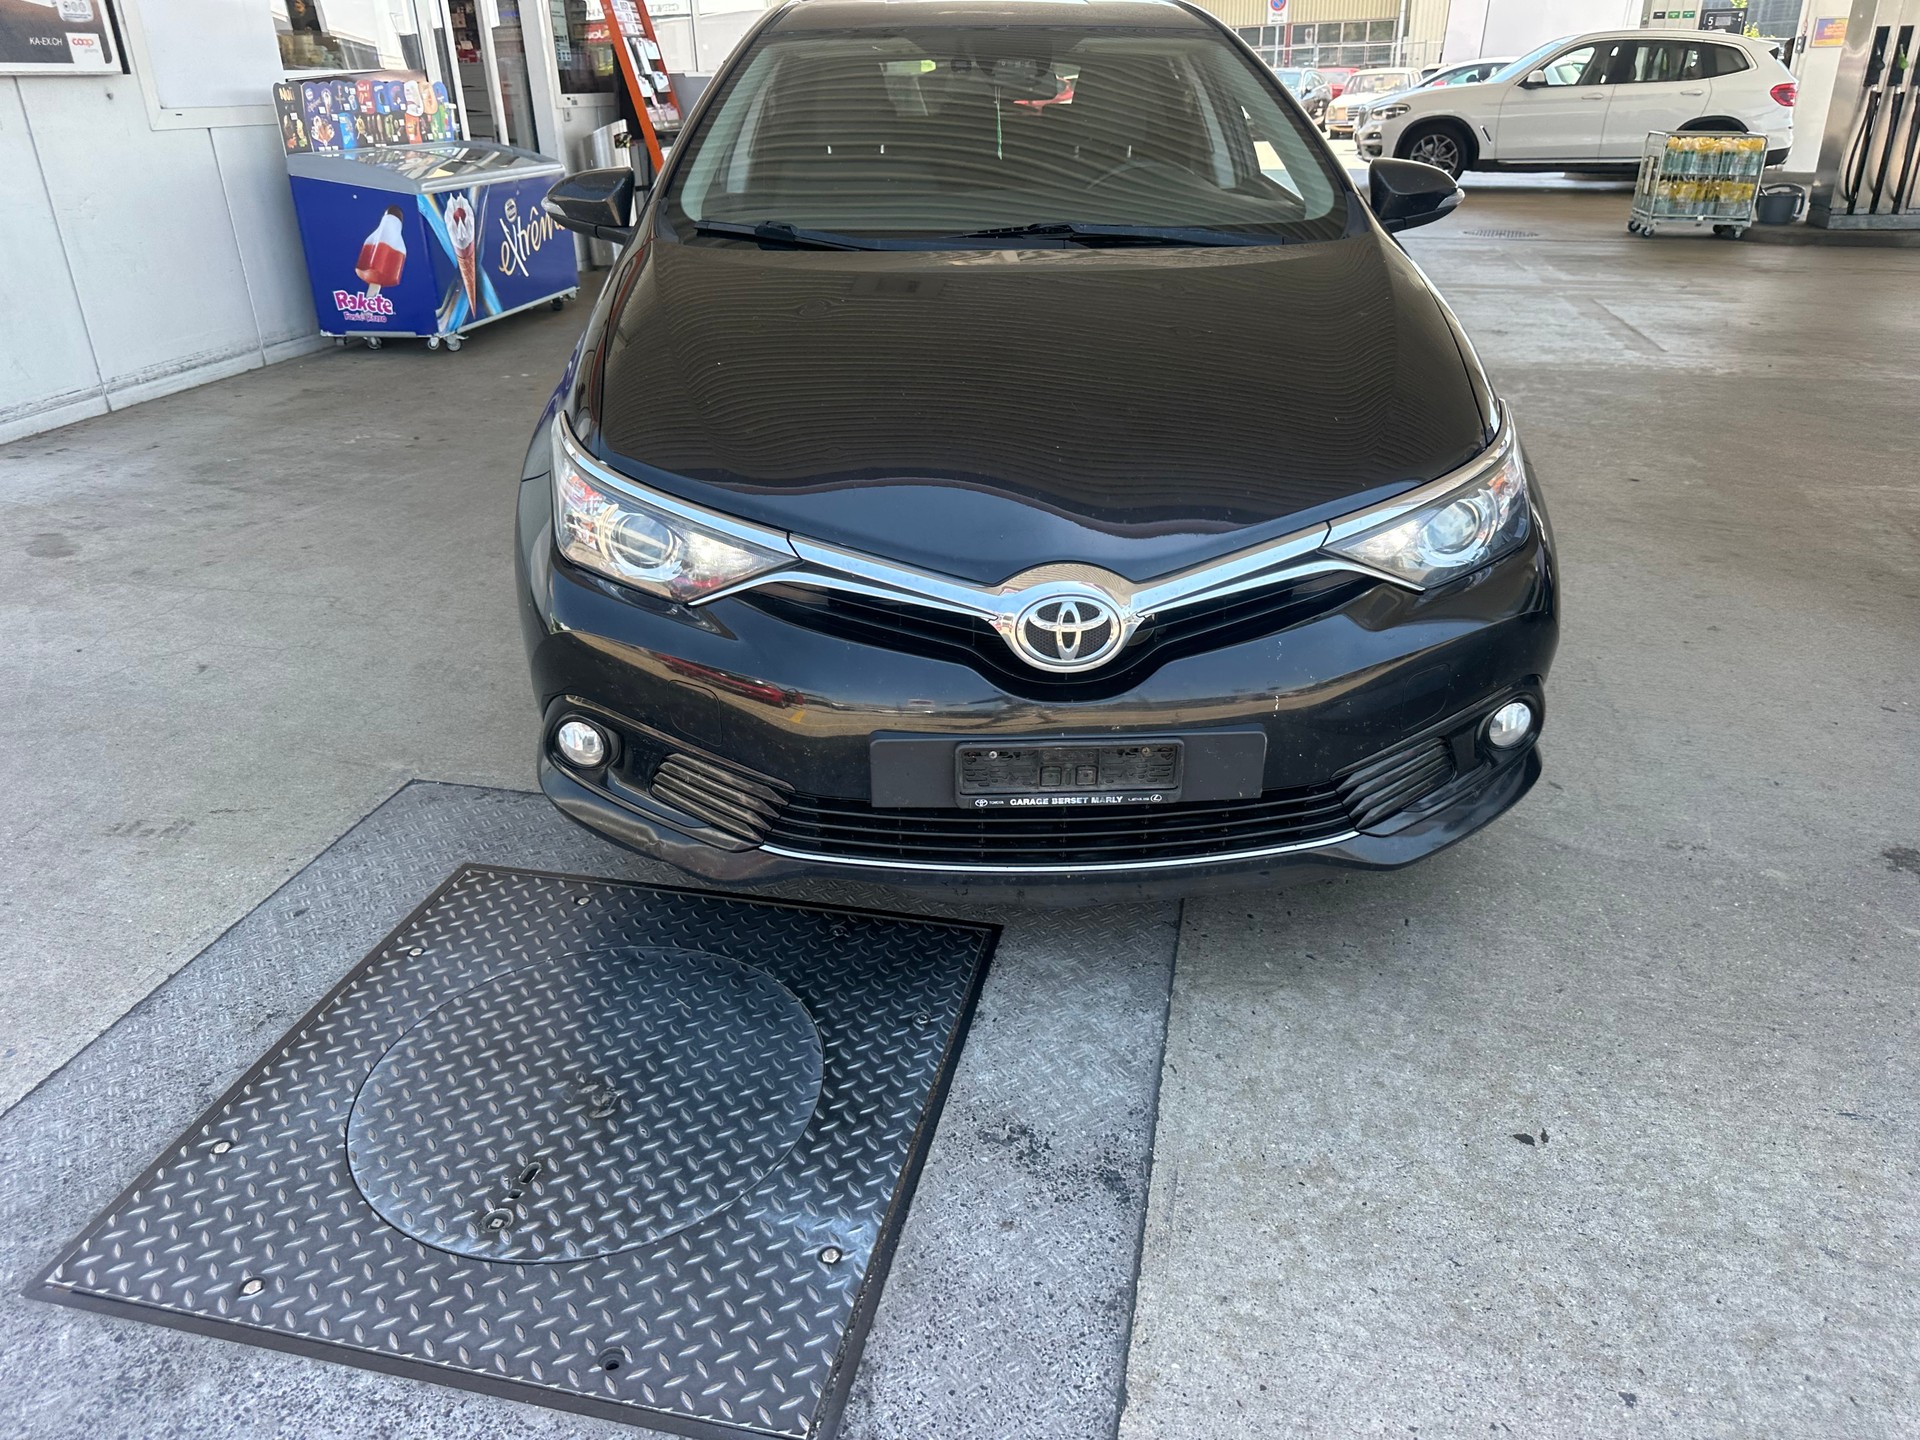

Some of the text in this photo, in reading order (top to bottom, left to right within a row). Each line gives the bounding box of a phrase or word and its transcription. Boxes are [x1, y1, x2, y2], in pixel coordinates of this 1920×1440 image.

[1707, 16, 1714, 26] 5
[72, 38, 94, 48] coop
[498, 206, 566, 277] extrêm
[333, 290, 394, 315] Rakete
[1009, 796, 1123, 806] GARAGE BERSET MARLY
